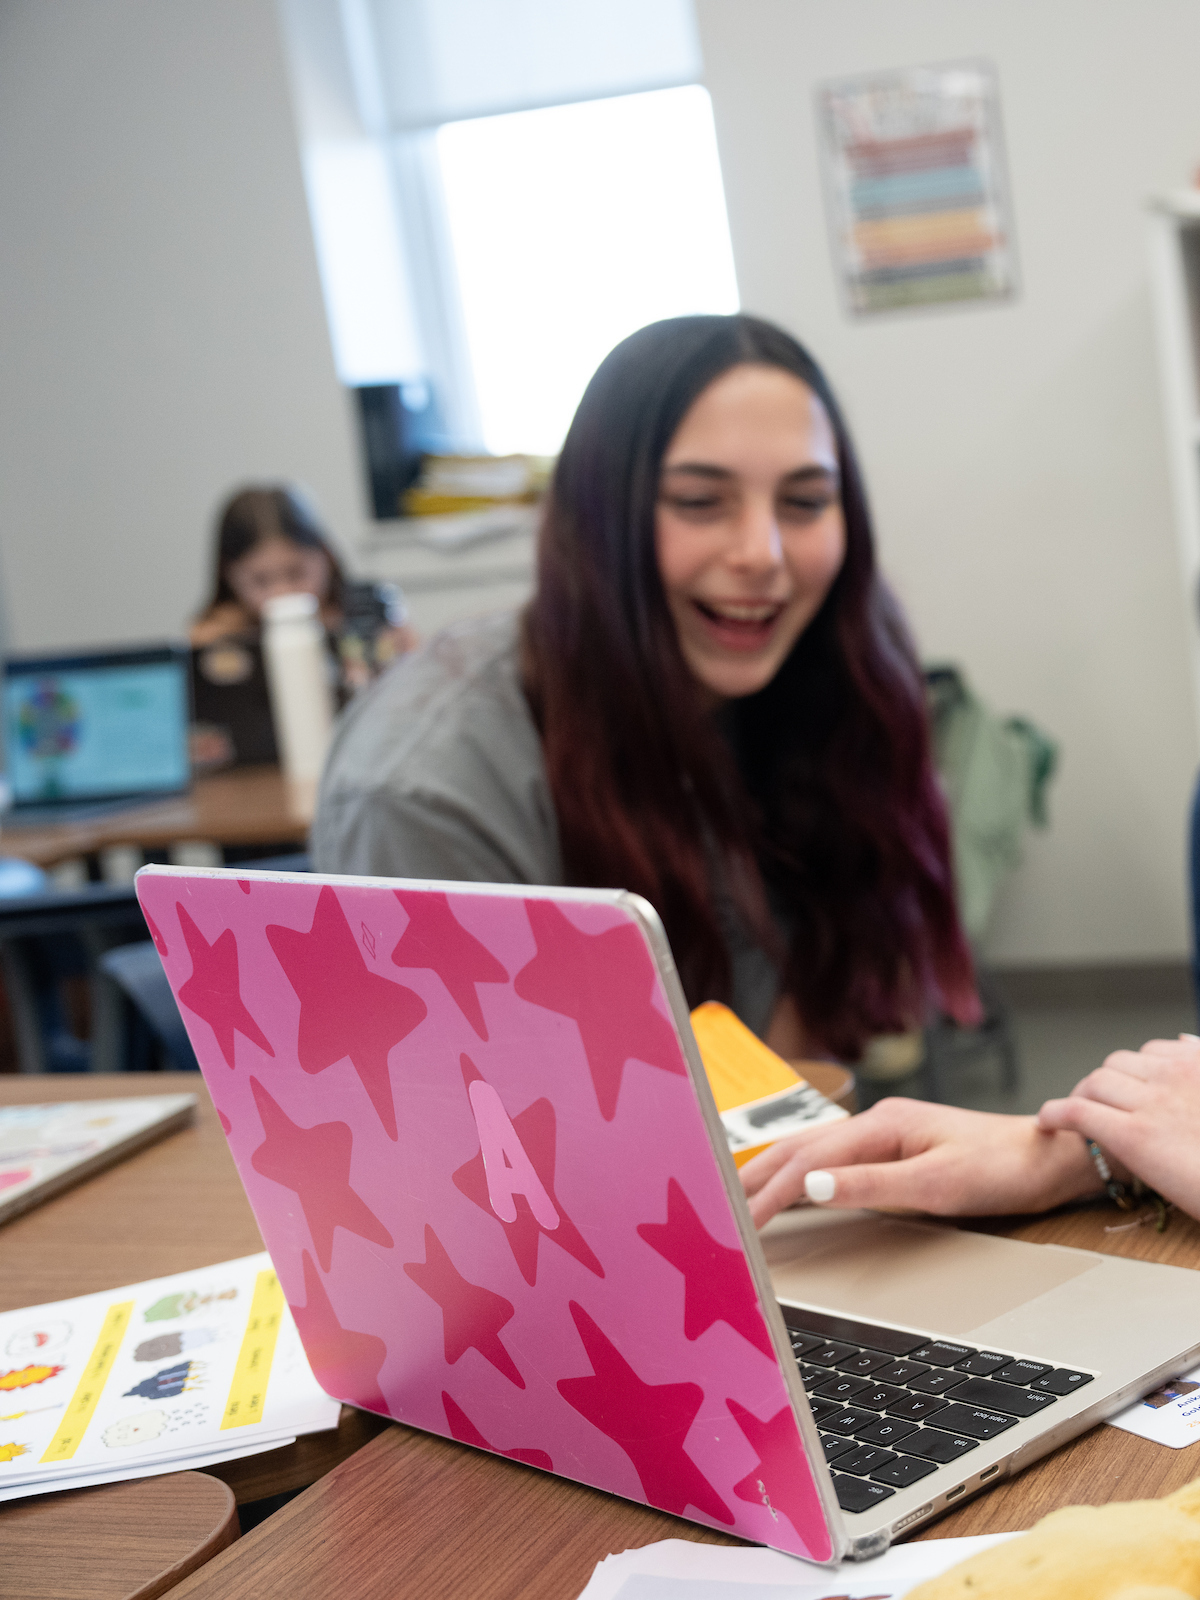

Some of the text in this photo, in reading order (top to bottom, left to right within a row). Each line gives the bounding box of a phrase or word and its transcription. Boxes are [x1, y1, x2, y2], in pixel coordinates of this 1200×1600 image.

[468, 1079, 561, 1231] A
[933, 1342, 968, 1353] command
[823, 1350, 836, 1358] V
[980, 1353, 1003, 1361] option
[1016, 1361, 1044, 1371] control
[837, 1383, 851, 1391] D
[1026, 1394, 1046, 1402] shift
[911, 1402, 924, 1410] A
[840, 1416, 855, 1425] W
[972, 1411, 1008, 1423] caps lock
[880, 1426, 893, 1434] Q
[826, 1440, 839, 1448] 2
[953, 1439, 968, 1447] tab
[868, 1486, 883, 1494] esc
